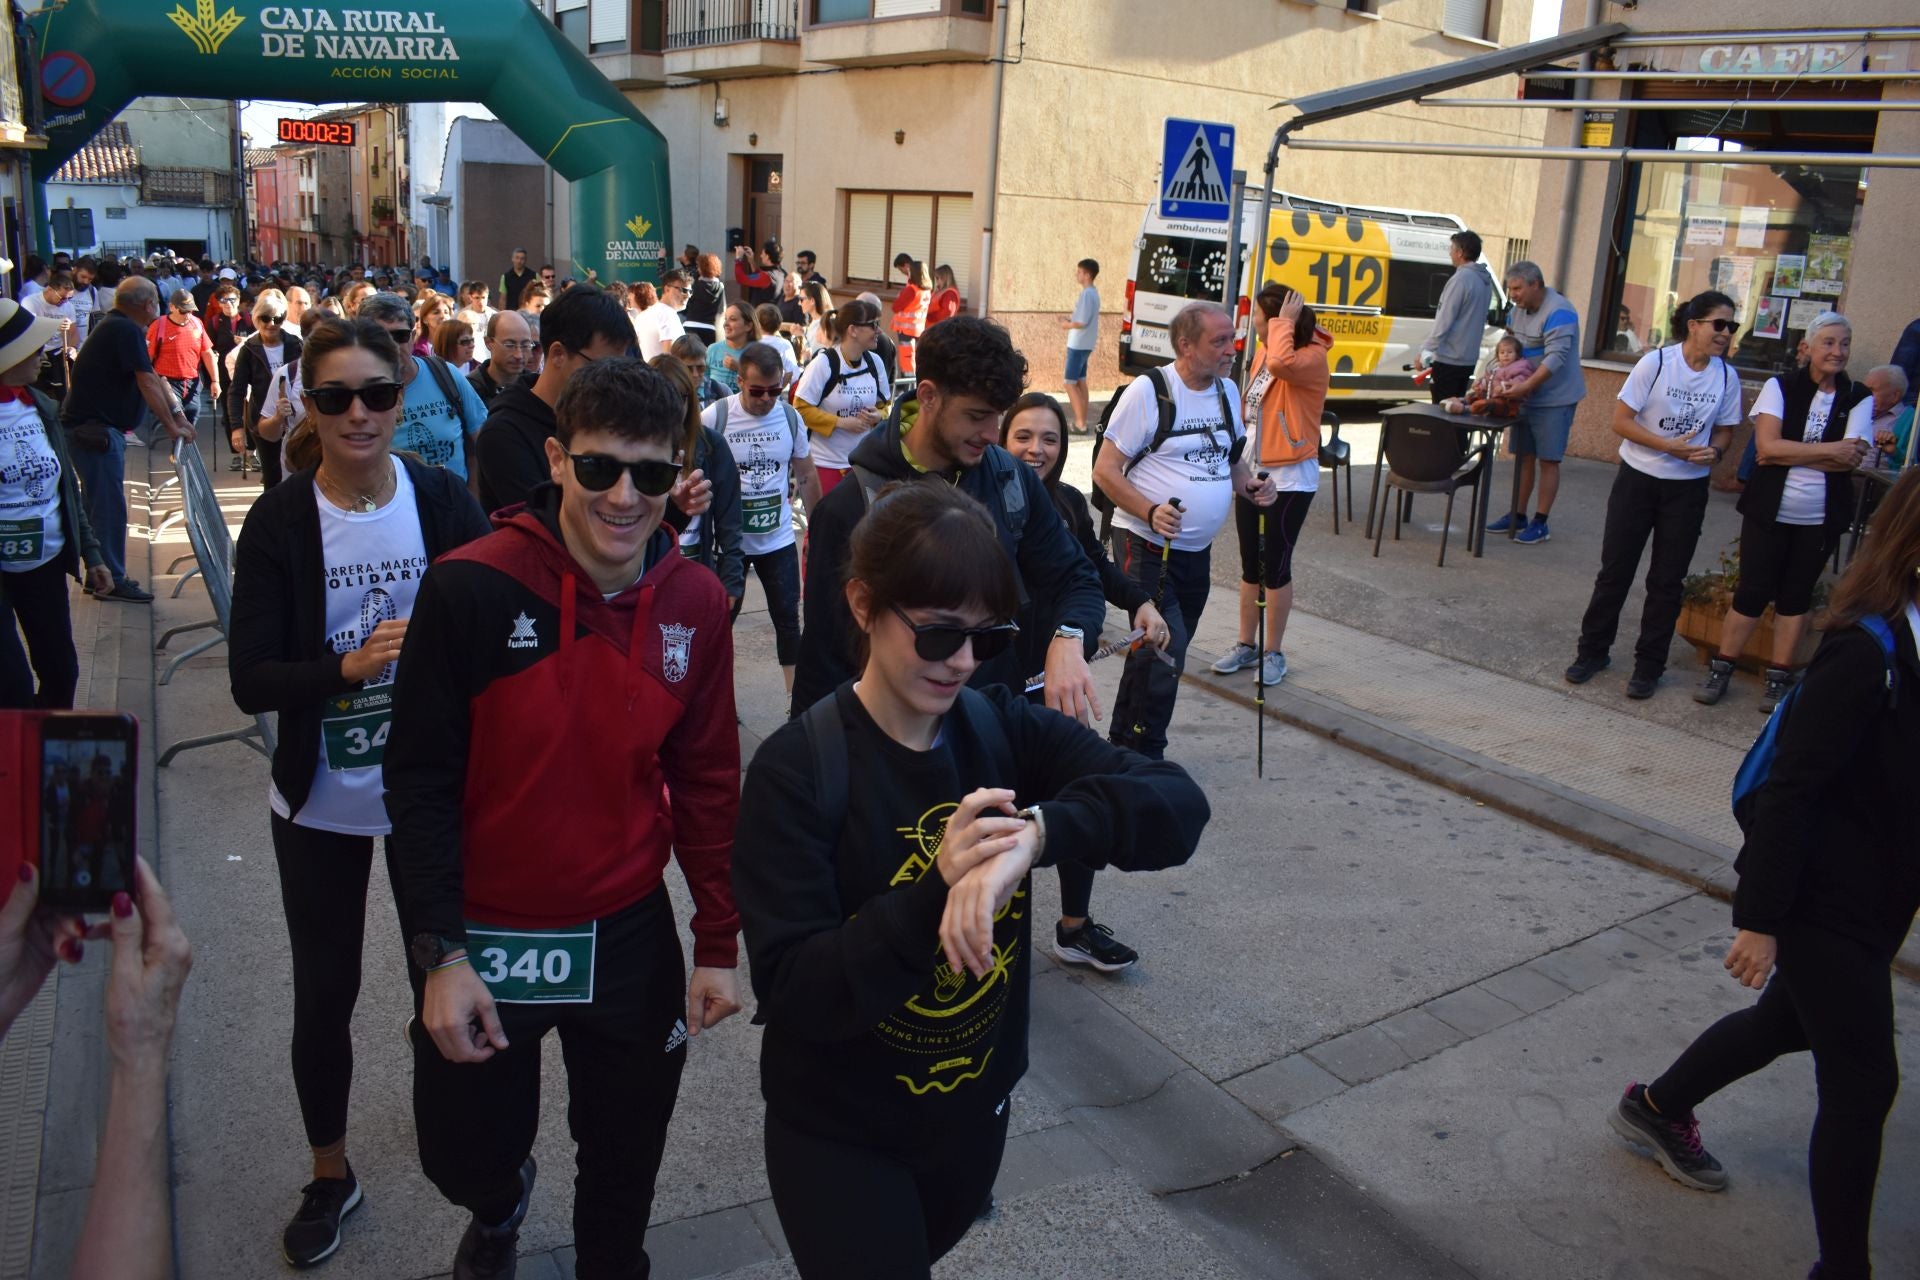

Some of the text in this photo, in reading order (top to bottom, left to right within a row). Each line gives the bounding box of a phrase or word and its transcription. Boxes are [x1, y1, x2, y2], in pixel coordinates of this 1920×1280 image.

[260, 7, 445, 34] CAJA RURAL
[261, 33, 460, 61] DE NAVARRA
[331, 66, 459, 79] ACCIÓN SOCIAL
[280, 120, 352, 144] 00:00:23
[607, 241, 633, 251] CAJA
[606, 251, 621, 260] DE
[1160, 256, 1178, 270] 112
[1309, 252, 1383, 315] 112
[0, 428, 46, 440] LIDARIA
[729, 436, 781, 444] SOLIDARIA
[748, 511, 778, 528] 422
[0, 540, 33, 555] 83
[508, 639, 538, 648] luanvi
[479, 947, 571, 984] 340
[917, 1036, 950, 1044] LINES
